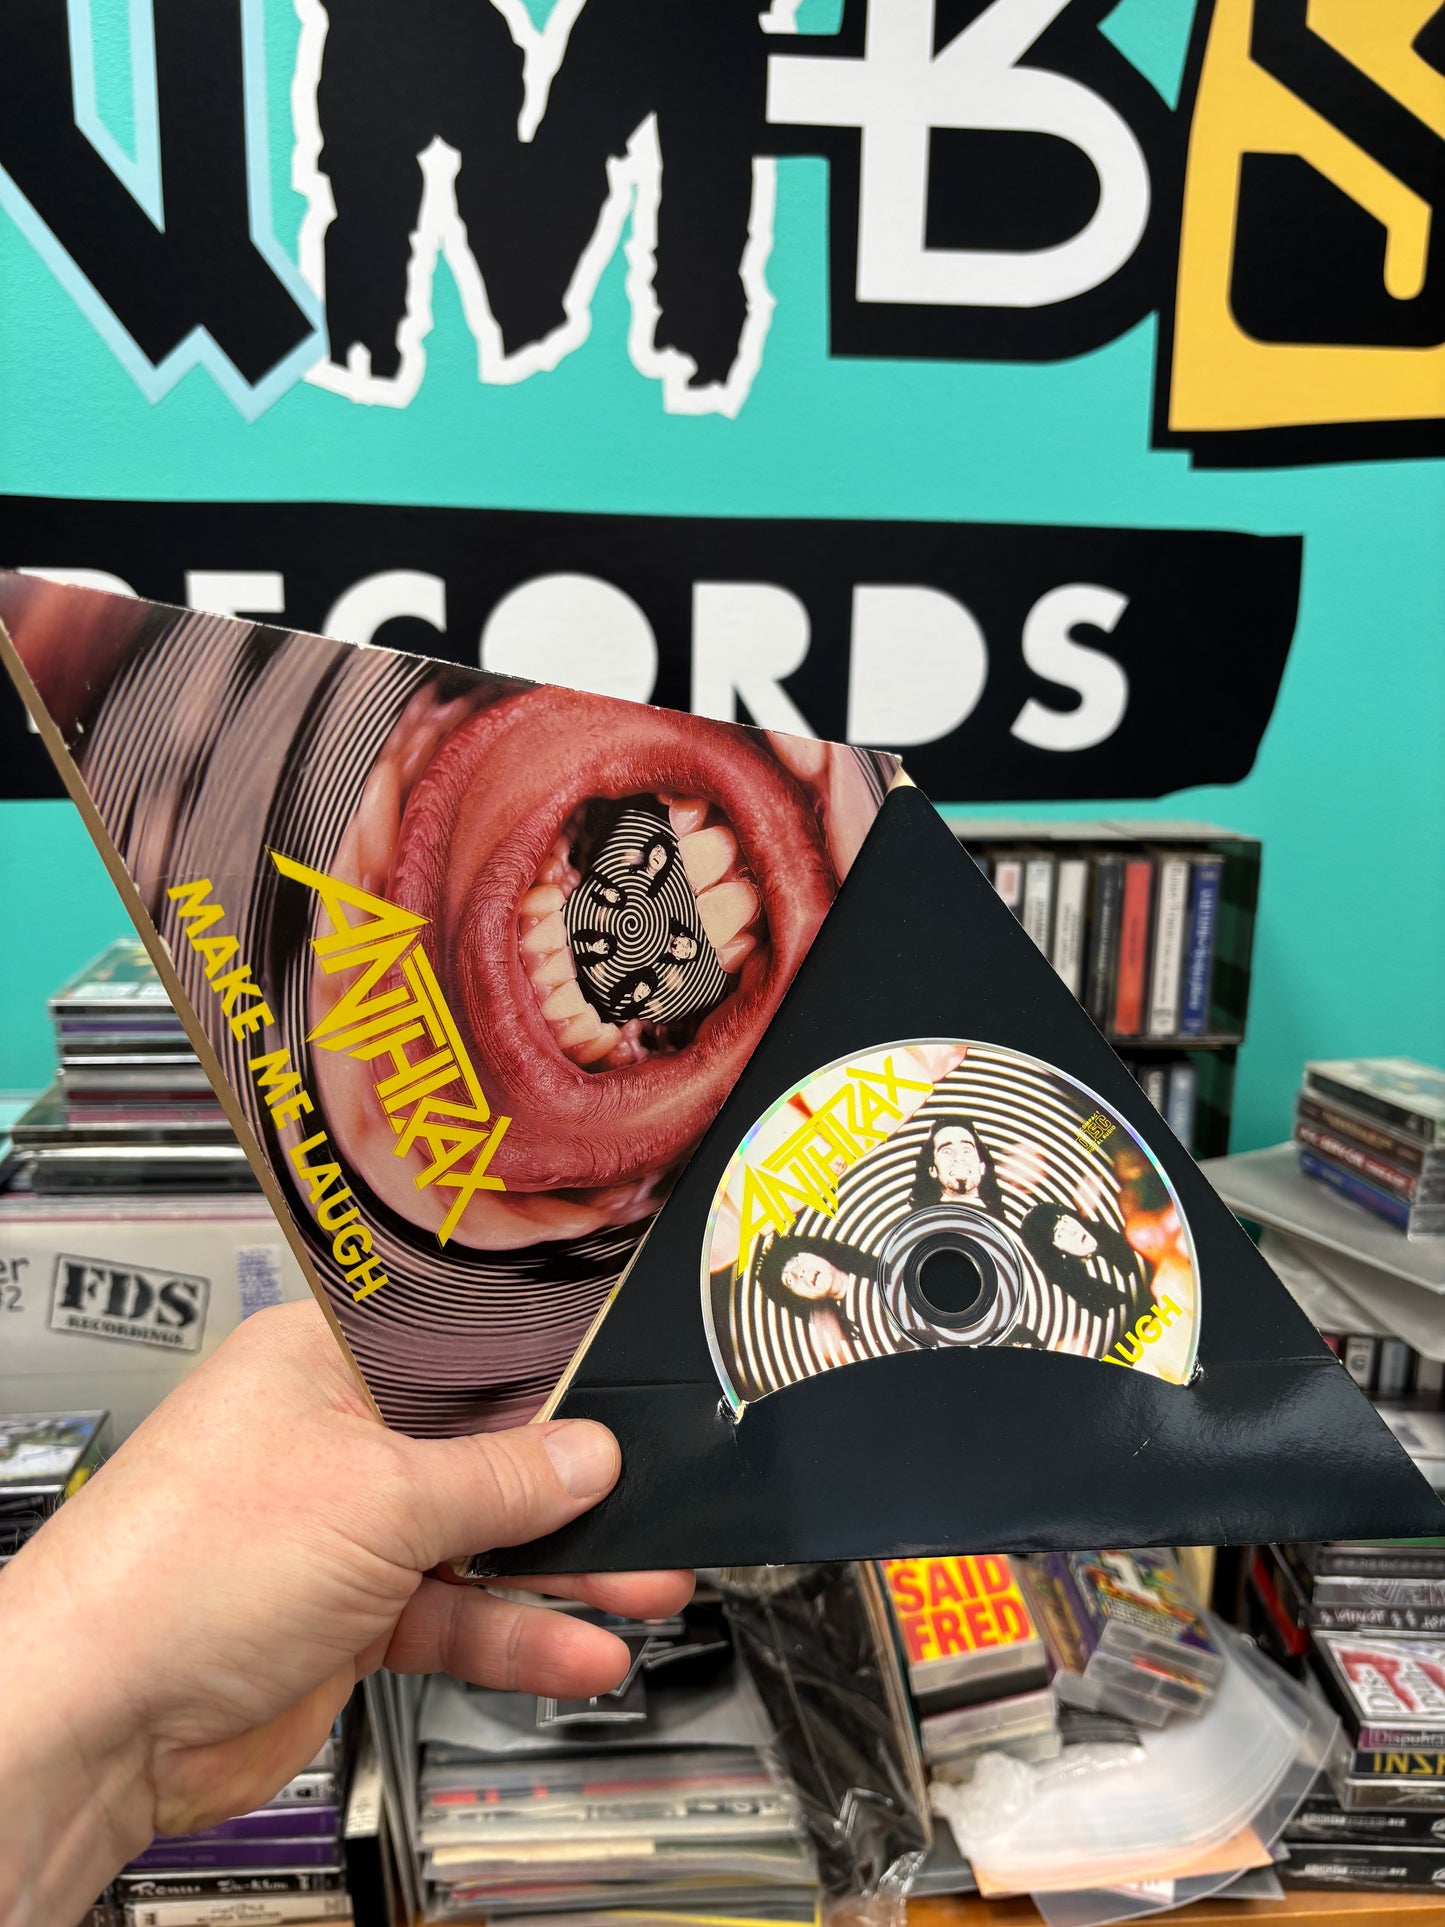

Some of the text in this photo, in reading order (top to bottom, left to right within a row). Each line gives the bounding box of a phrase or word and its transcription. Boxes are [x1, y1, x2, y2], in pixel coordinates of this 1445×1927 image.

[168, 878, 275, 1042] MAKE
[249, 1048, 315, 1130] ME
[288, 1131, 389, 1302] LAUGH
[265, 845, 512, 1248] ANTHRAX
[736, 1055, 935, 1280] ANTHRAX
[57, 1262, 201, 1330] FDS
[892, 1554, 1012, 1613] SAID
[902, 1597, 1031, 1665] FRED
